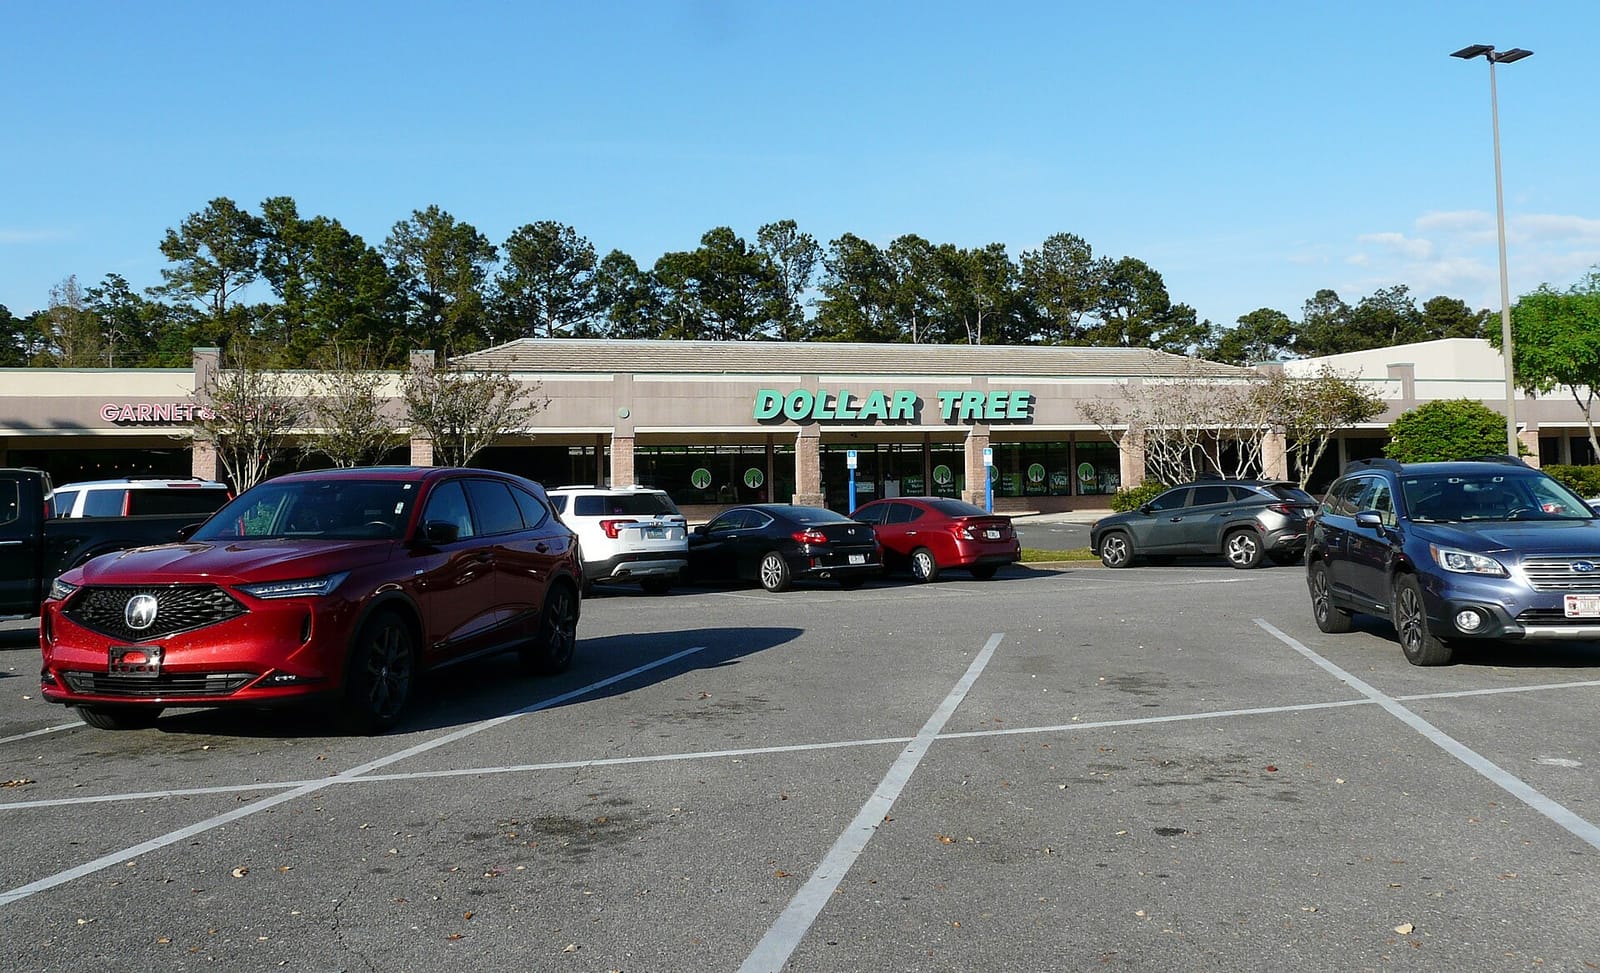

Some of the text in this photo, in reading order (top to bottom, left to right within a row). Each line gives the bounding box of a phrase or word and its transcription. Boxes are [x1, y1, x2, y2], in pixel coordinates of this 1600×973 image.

[100, 403, 196, 421] GARNET
[200, 403, 216, 421] &
[753, 389, 1032, 421] DOLLAR TREE
